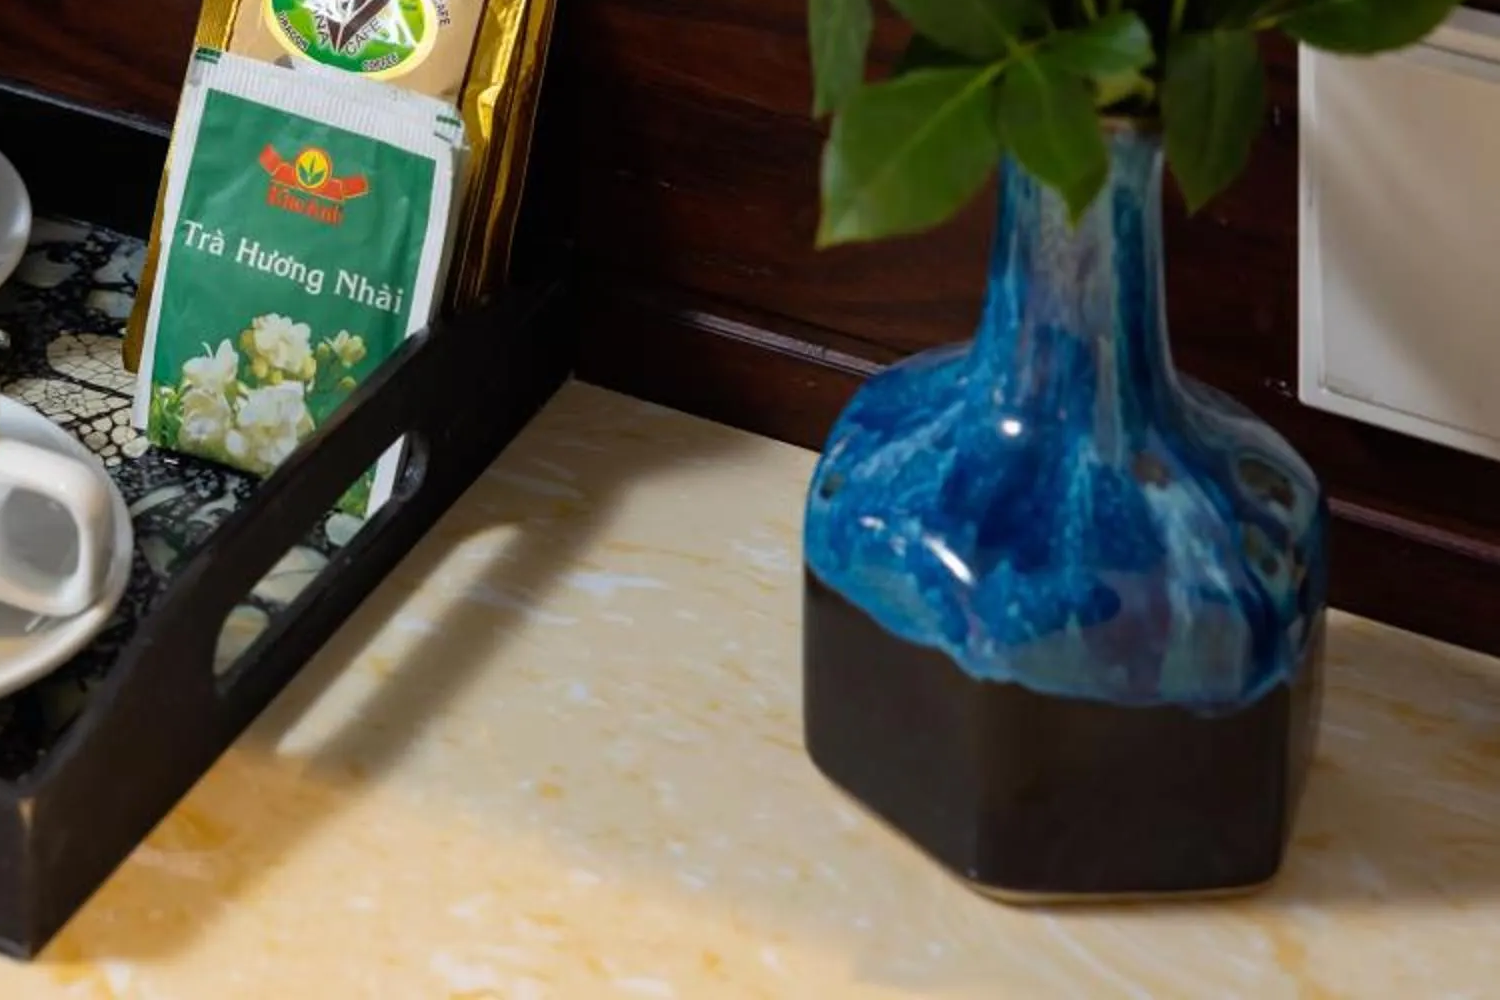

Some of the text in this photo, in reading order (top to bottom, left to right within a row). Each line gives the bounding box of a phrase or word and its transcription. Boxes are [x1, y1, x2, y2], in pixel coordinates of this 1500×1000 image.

[184, 220, 404, 314] Trà Hương Nhài
